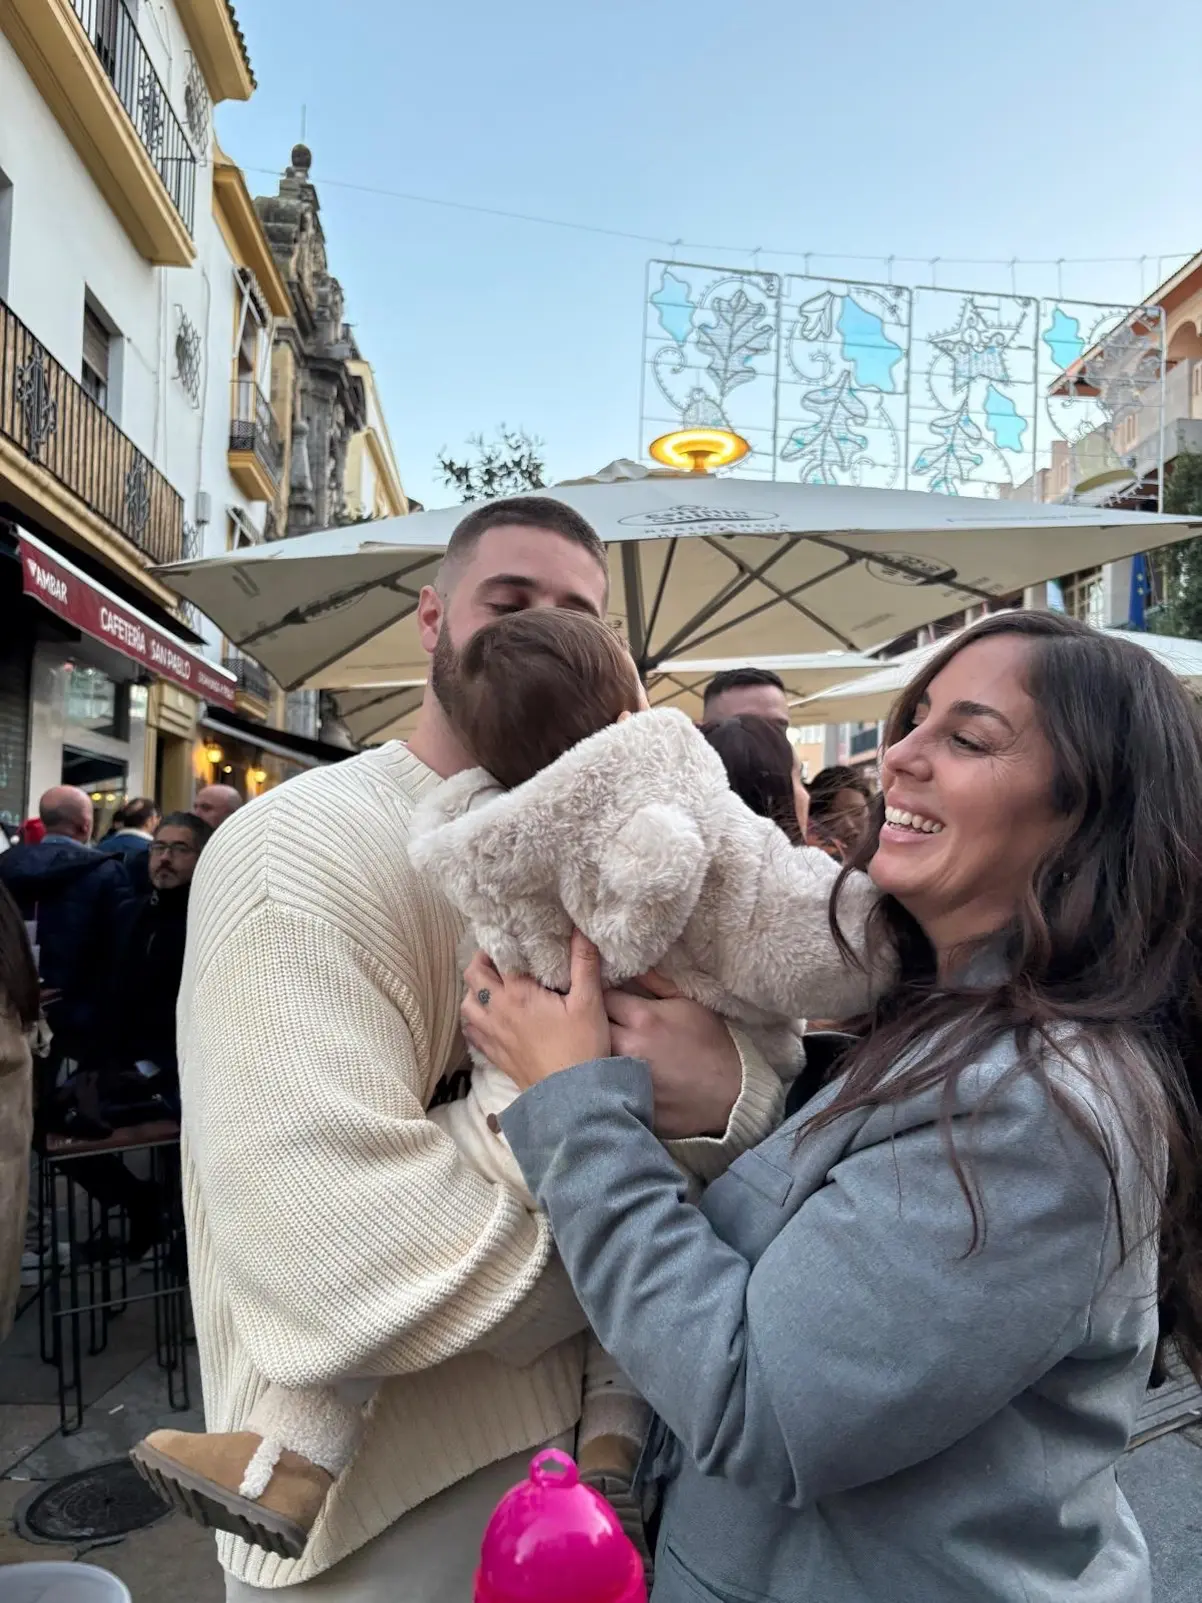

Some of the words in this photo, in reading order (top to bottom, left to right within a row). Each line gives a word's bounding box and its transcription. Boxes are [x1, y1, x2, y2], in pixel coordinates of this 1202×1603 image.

[36, 566, 68, 604] AMBAR
[151, 639, 168, 666] SAN
[167, 649, 191, 680] PABLO
